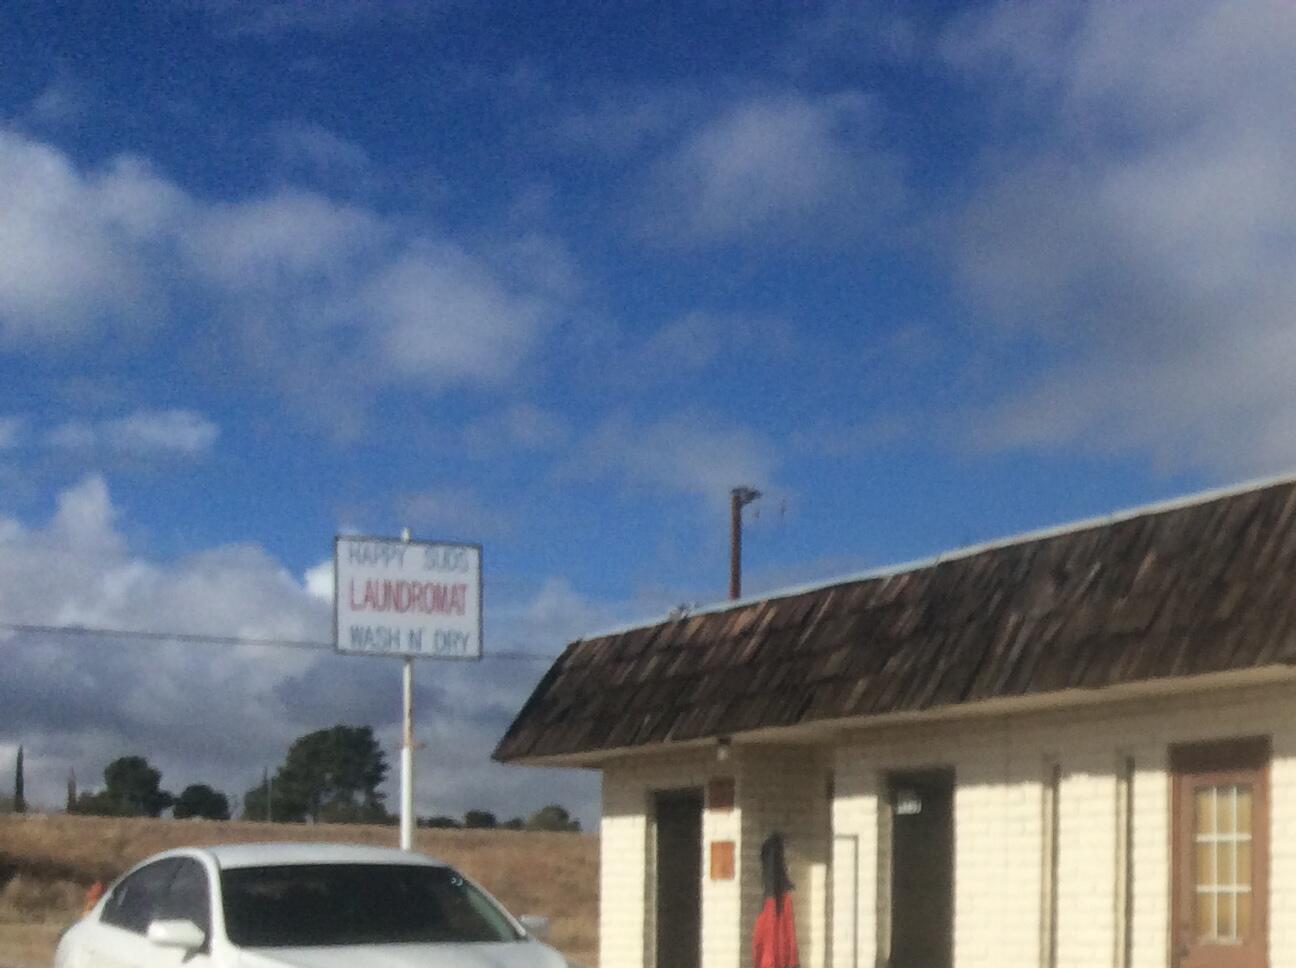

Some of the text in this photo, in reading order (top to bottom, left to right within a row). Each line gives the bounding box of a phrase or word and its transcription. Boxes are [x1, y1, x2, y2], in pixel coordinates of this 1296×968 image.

[349, 542, 406, 569] HAPPY
[350, 577, 467, 616] LAUNDROMAT
[350, 624, 400, 651] WASH
[434, 629, 471, 653] DRY
